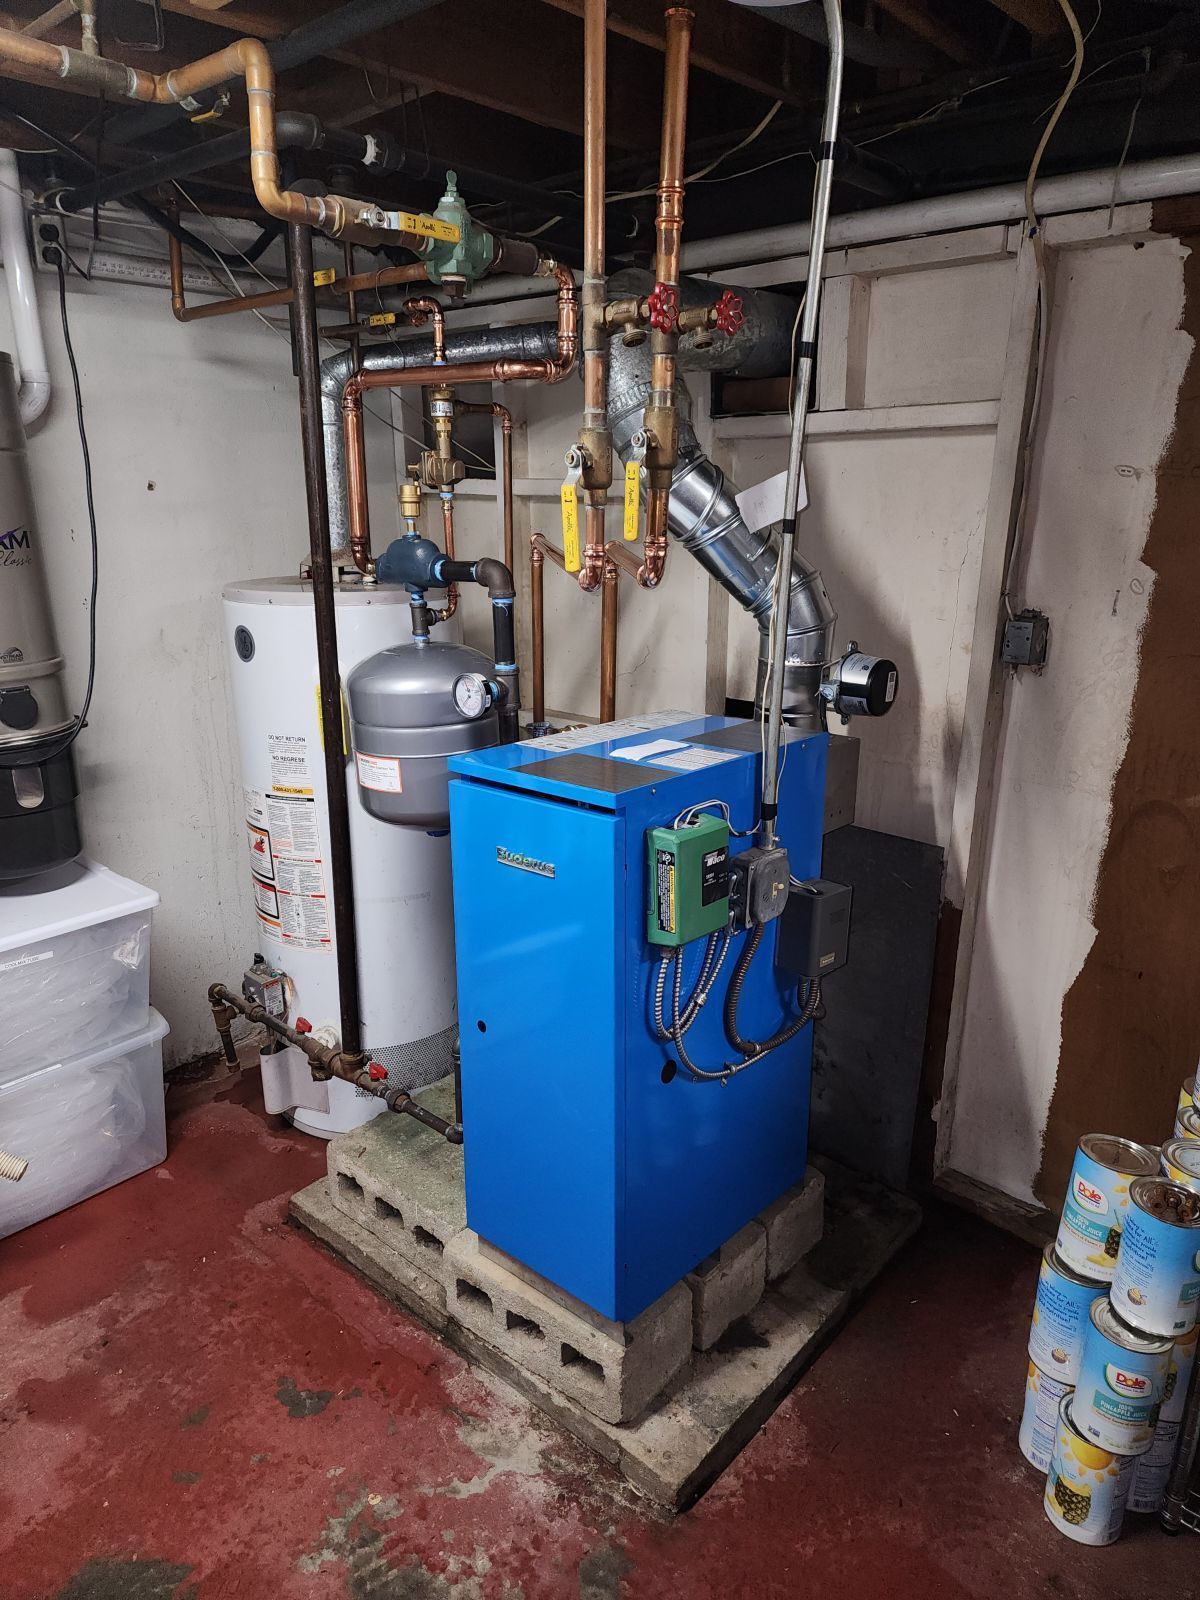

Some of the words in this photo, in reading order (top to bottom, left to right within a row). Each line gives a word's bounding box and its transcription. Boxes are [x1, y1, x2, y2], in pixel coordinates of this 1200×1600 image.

[280, 755, 305, 763] REGRESE
[496, 846, 555, 875] Buderus
[704, 854, 726, 867] Taco
[1078, 1181, 1102, 1202] Dole
[1116, 1372, 1146, 1388] Dole
[1100, 1400, 1131, 1417] PINEAPPLE
